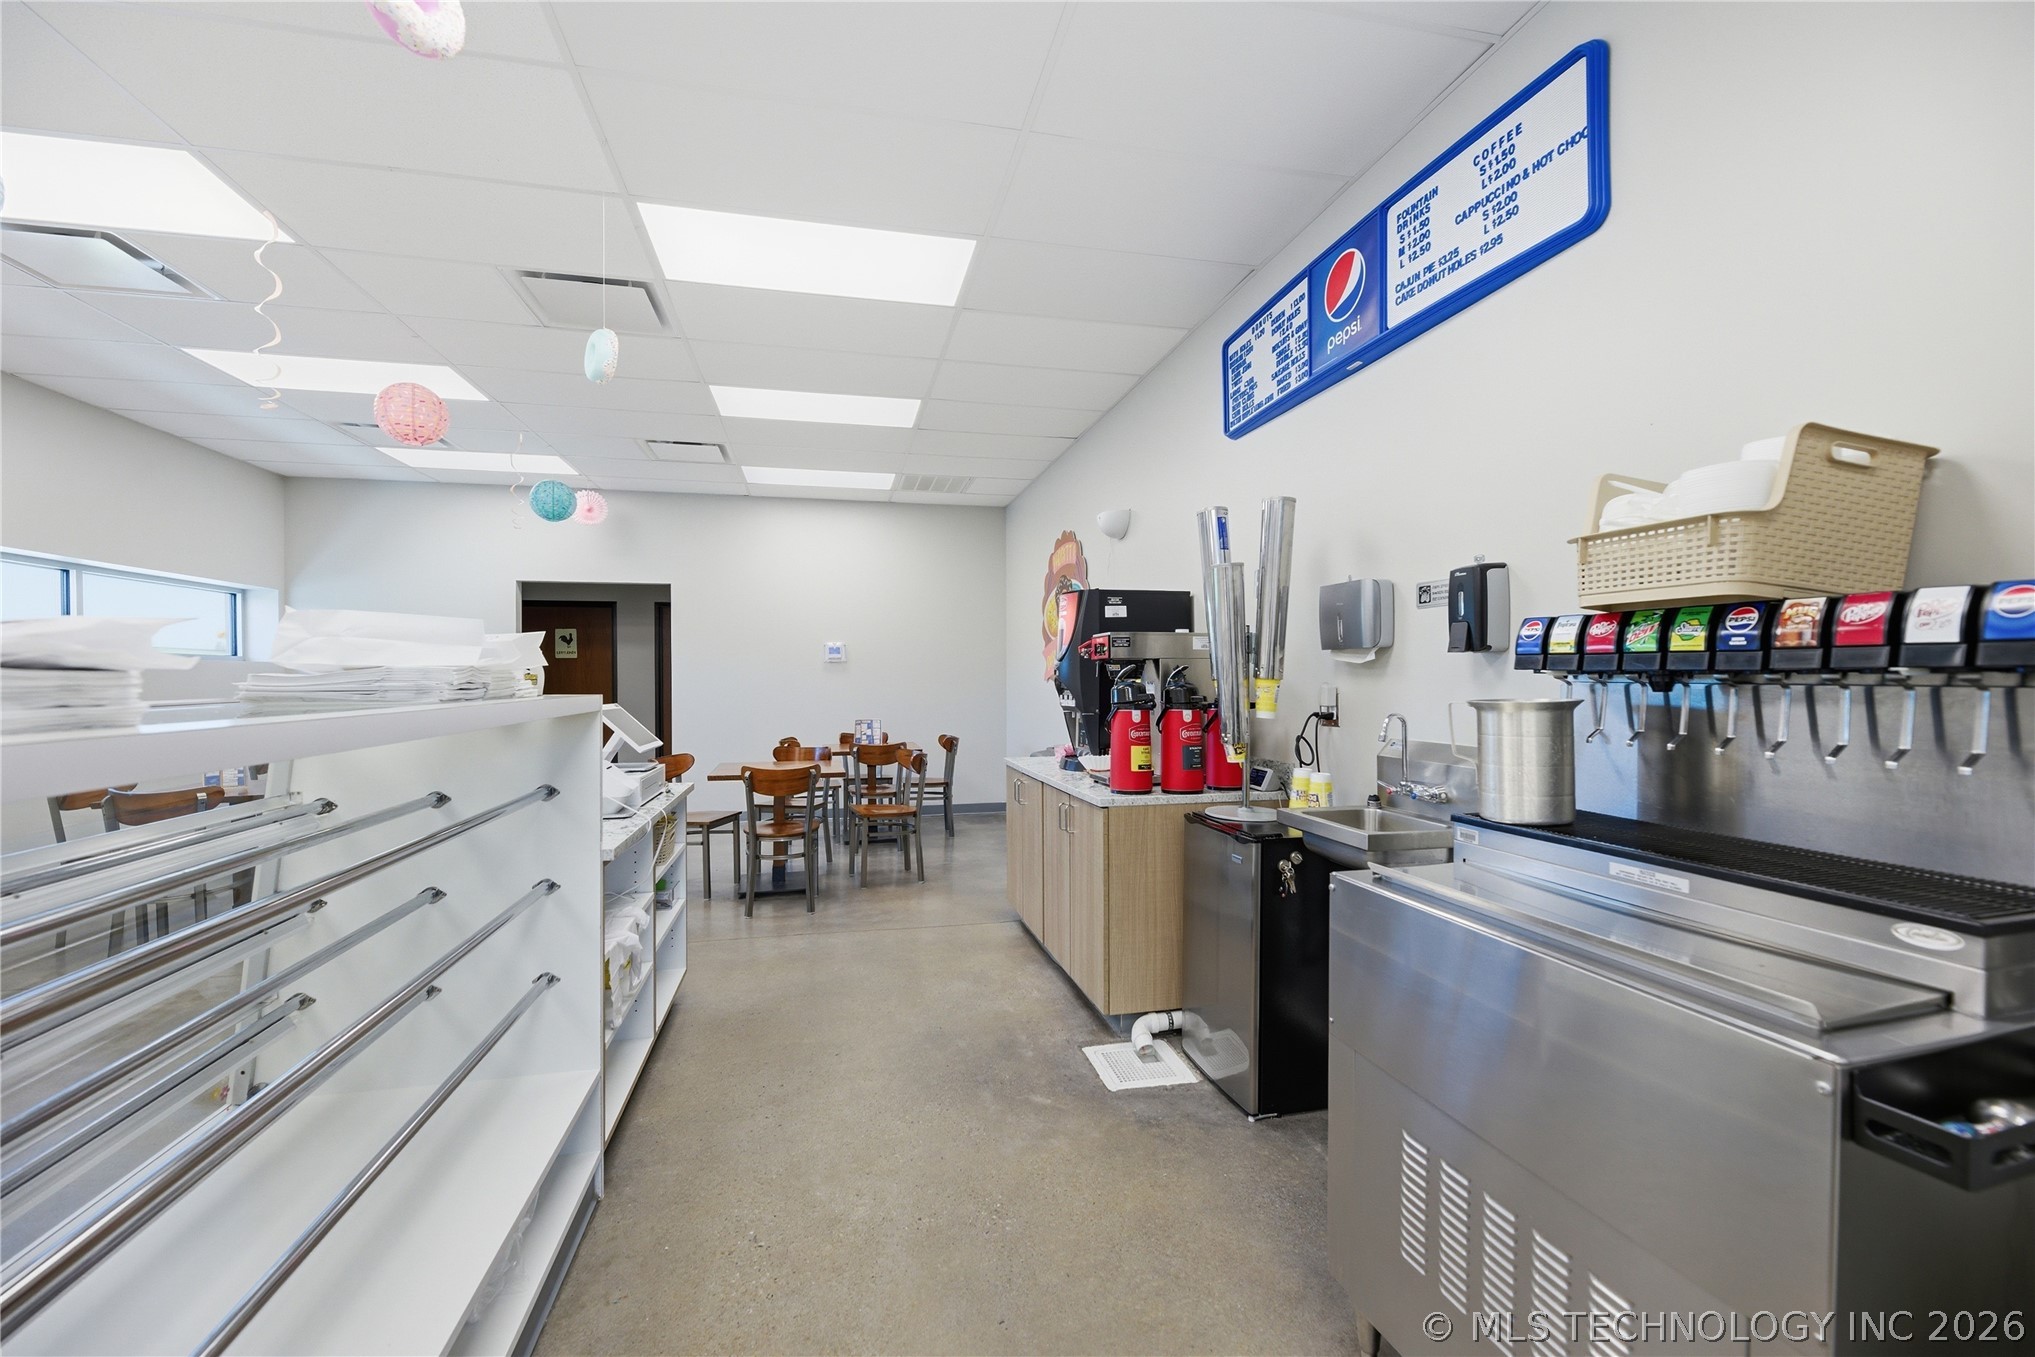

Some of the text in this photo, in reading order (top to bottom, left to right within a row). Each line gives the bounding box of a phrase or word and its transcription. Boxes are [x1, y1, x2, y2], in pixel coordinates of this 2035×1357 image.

[1473, 122, 1523, 167] COFFEE
[1479, 165, 1487, 177] S
[1481, 157, 1517, 190] L $2.00
[1454, 174, 1521, 226] CAPPUCCINO
[1522, 167, 1530, 180] &
[1532, 151, 1555, 175] HOT
[1396, 186, 1439, 224] FOUNTAIN
[1396, 203, 1431, 235] DRINKS
[1482, 191, 1518, 221] S $2.00
[1483, 204, 1519, 235] L $2.50
[1399, 233, 1406, 245] S
[1399, 241, 1432, 269] L $2.50
[1407, 230, 1431, 253] $2.00
[1395, 272, 1421, 295] CAJUN
[1422, 260, 1436, 279] PIE
[1395, 289, 1416, 307] CAKE
[1417, 271, 1446, 295] DONUT
[1446, 251, 1477, 278] HOLES
[1327, 315, 1361, 355] pepsi
